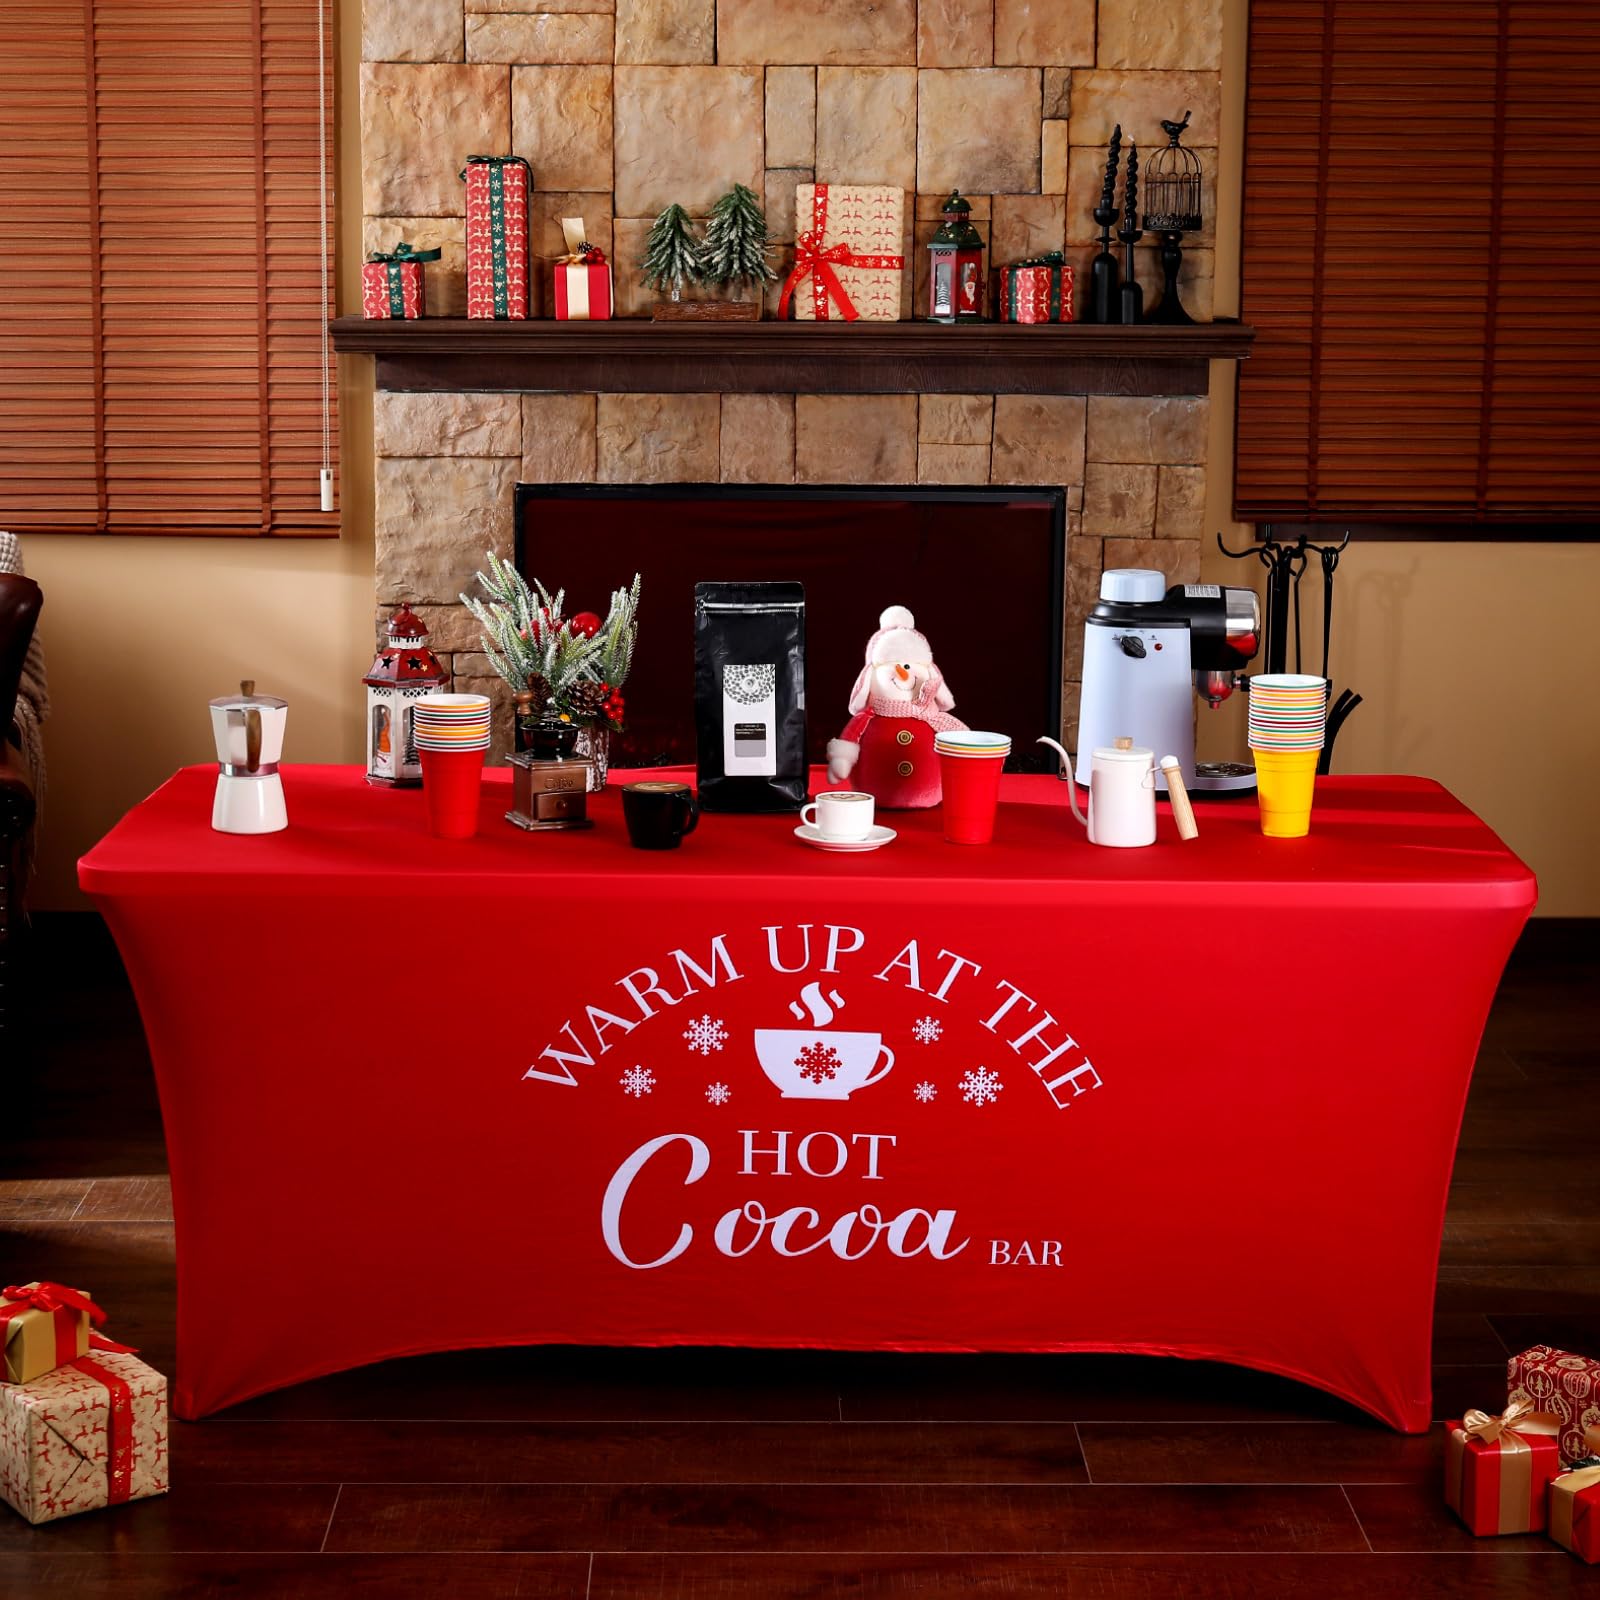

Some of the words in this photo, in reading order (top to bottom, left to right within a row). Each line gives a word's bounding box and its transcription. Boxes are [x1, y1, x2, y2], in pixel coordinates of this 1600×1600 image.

[522, 933, 745, 1087] WARM
[761, 924, 865, 974] UP
[873, 939, 982, 1003] AT
[979, 979, 1103, 1110] THE
[601, 1133, 970, 1269] Cocoa
[988, 1239, 1064, 1267] BAR
[737, 1129, 897, 1180] HOT
